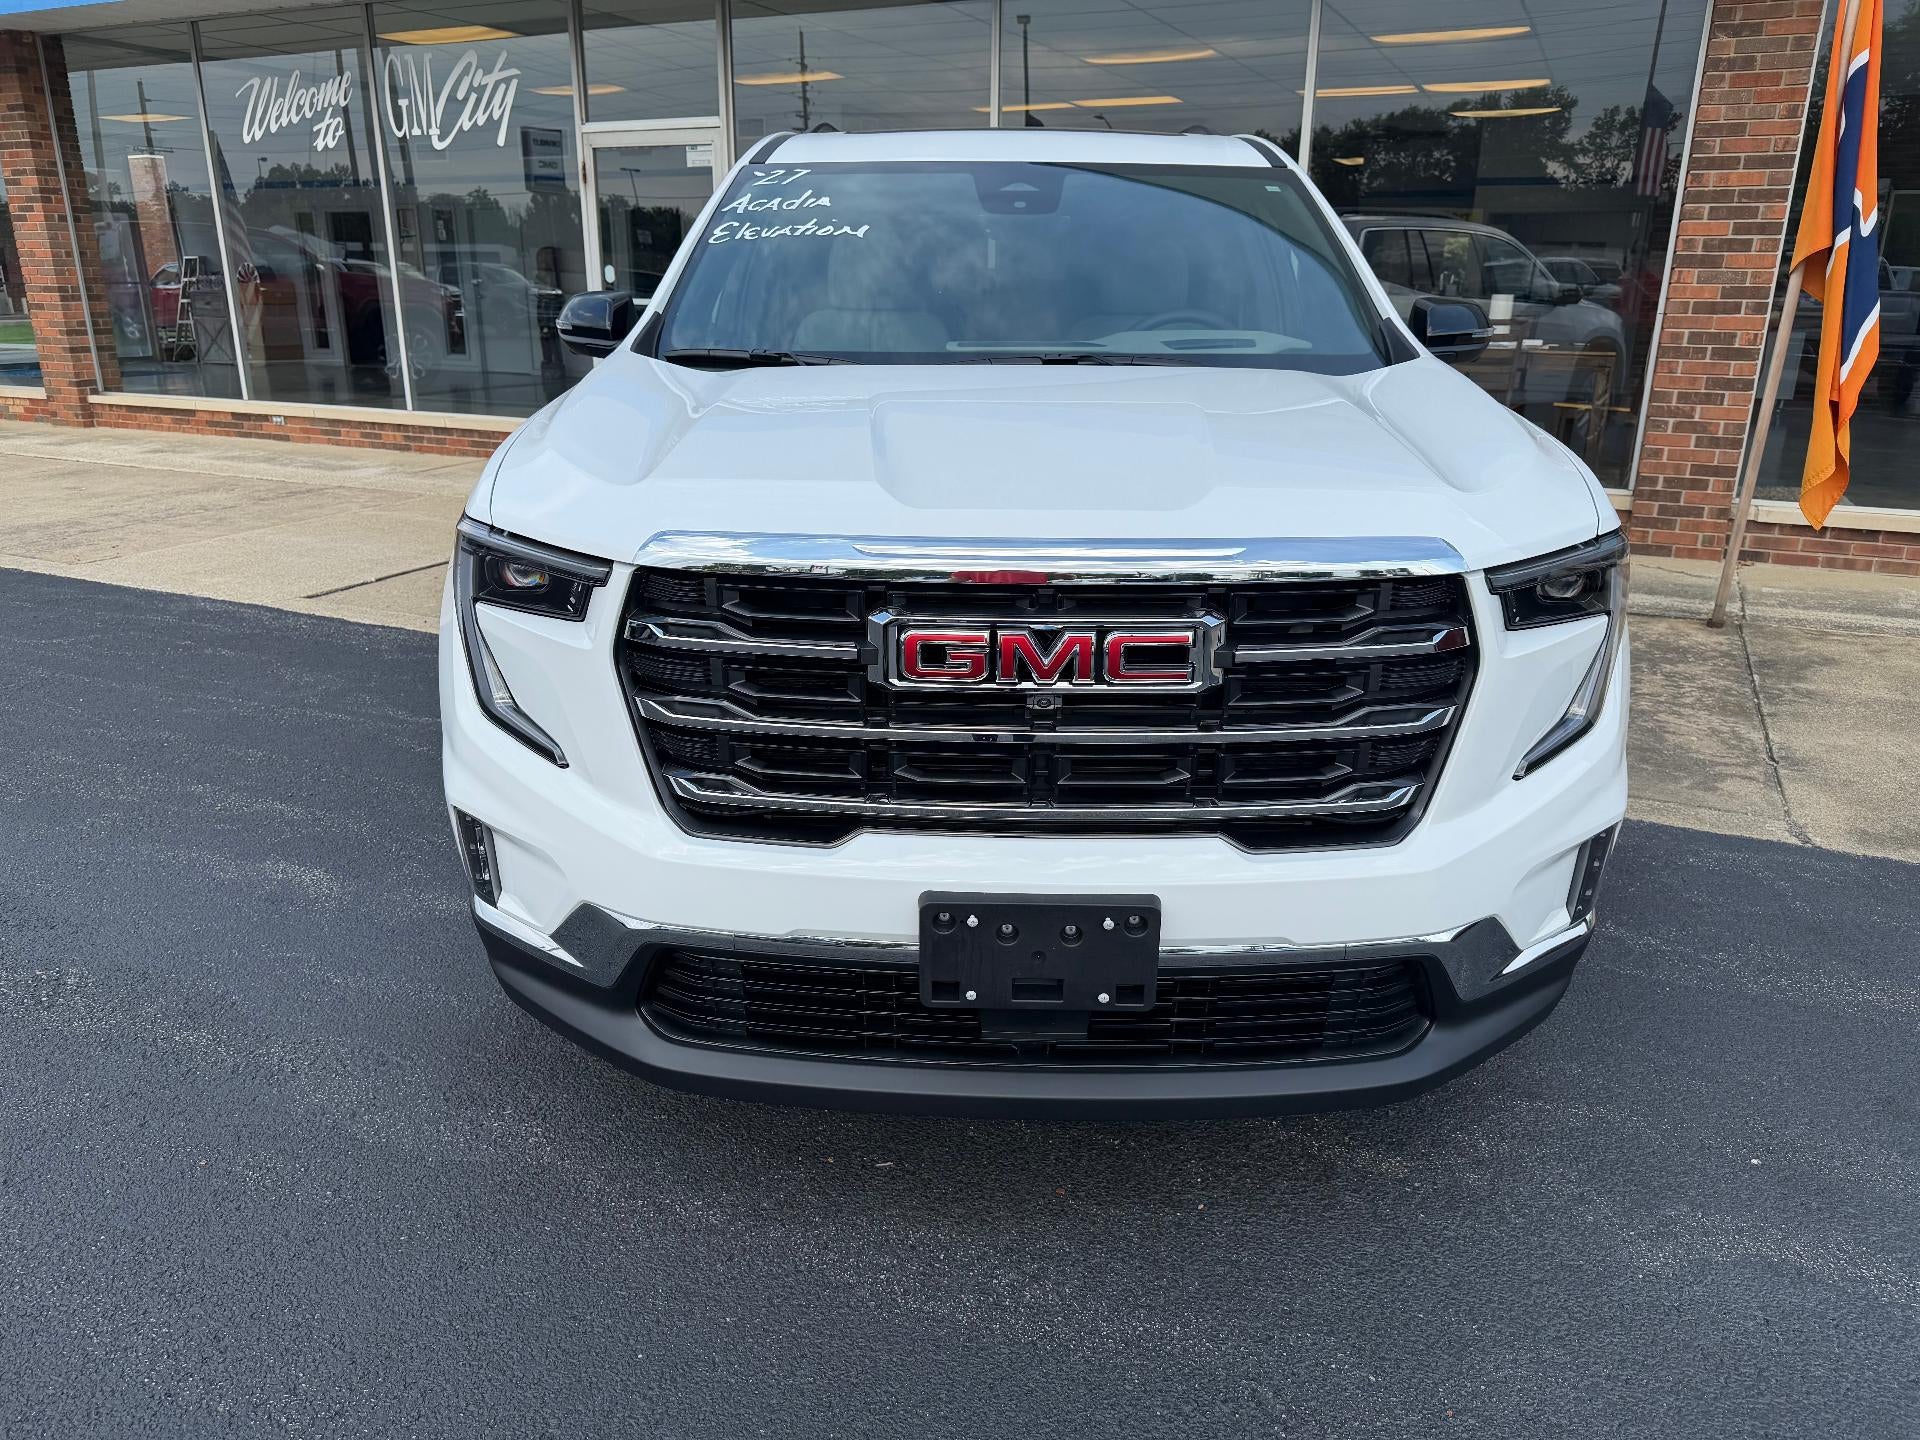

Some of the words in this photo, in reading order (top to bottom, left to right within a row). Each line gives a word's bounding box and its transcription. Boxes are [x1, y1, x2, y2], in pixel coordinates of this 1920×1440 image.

[235, 70, 353, 144] Welcome
[313, 109, 345, 151] to
[899, 630, 1196, 686] GMC
